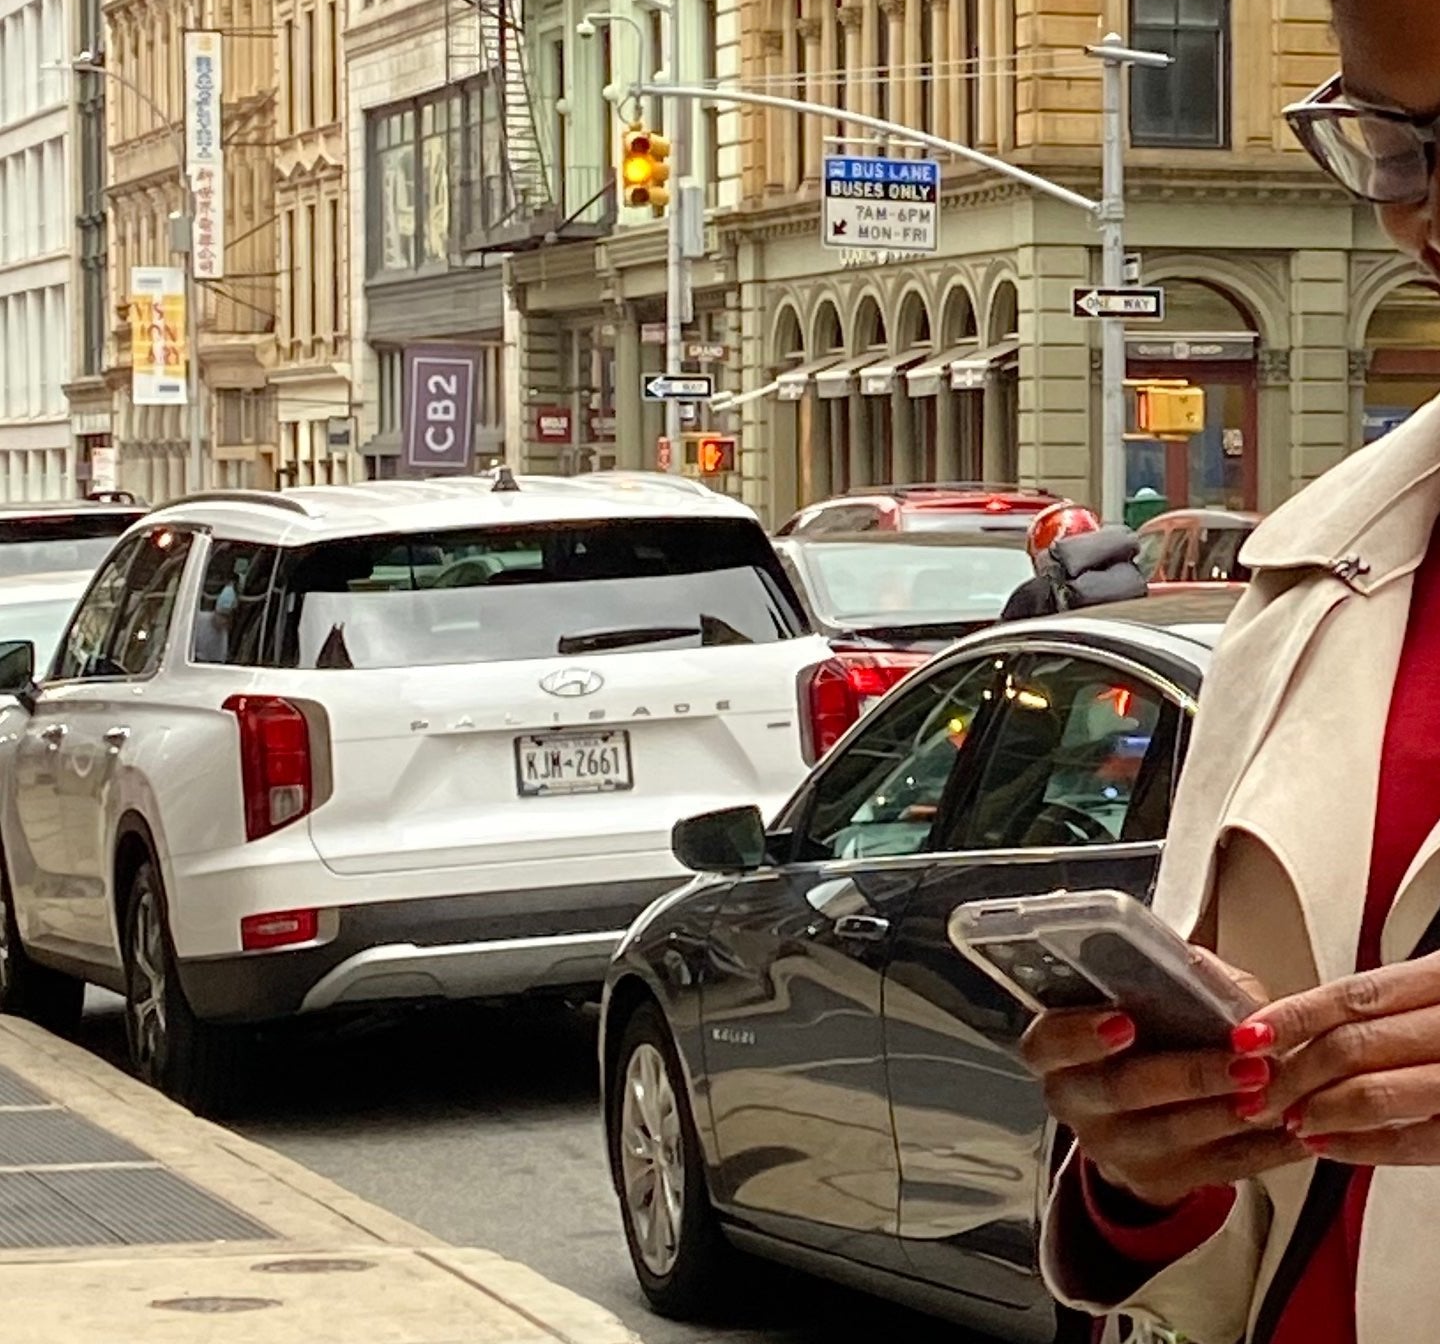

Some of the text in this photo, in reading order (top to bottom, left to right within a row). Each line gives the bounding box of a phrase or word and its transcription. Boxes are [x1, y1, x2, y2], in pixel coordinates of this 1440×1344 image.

[852, 162, 932, 181] BUS LANE
[830, 180, 930, 201] BUSES ONLY
[856, 205, 931, 224] 7AM-6PM
[858, 225, 927, 242] MON-FRI
[1086, 297, 1149, 310] ONE WAY
[689, 345, 723, 358] GRAND
[425, 374, 457, 453] CB2
[409, 699, 732, 730] PALISADE
